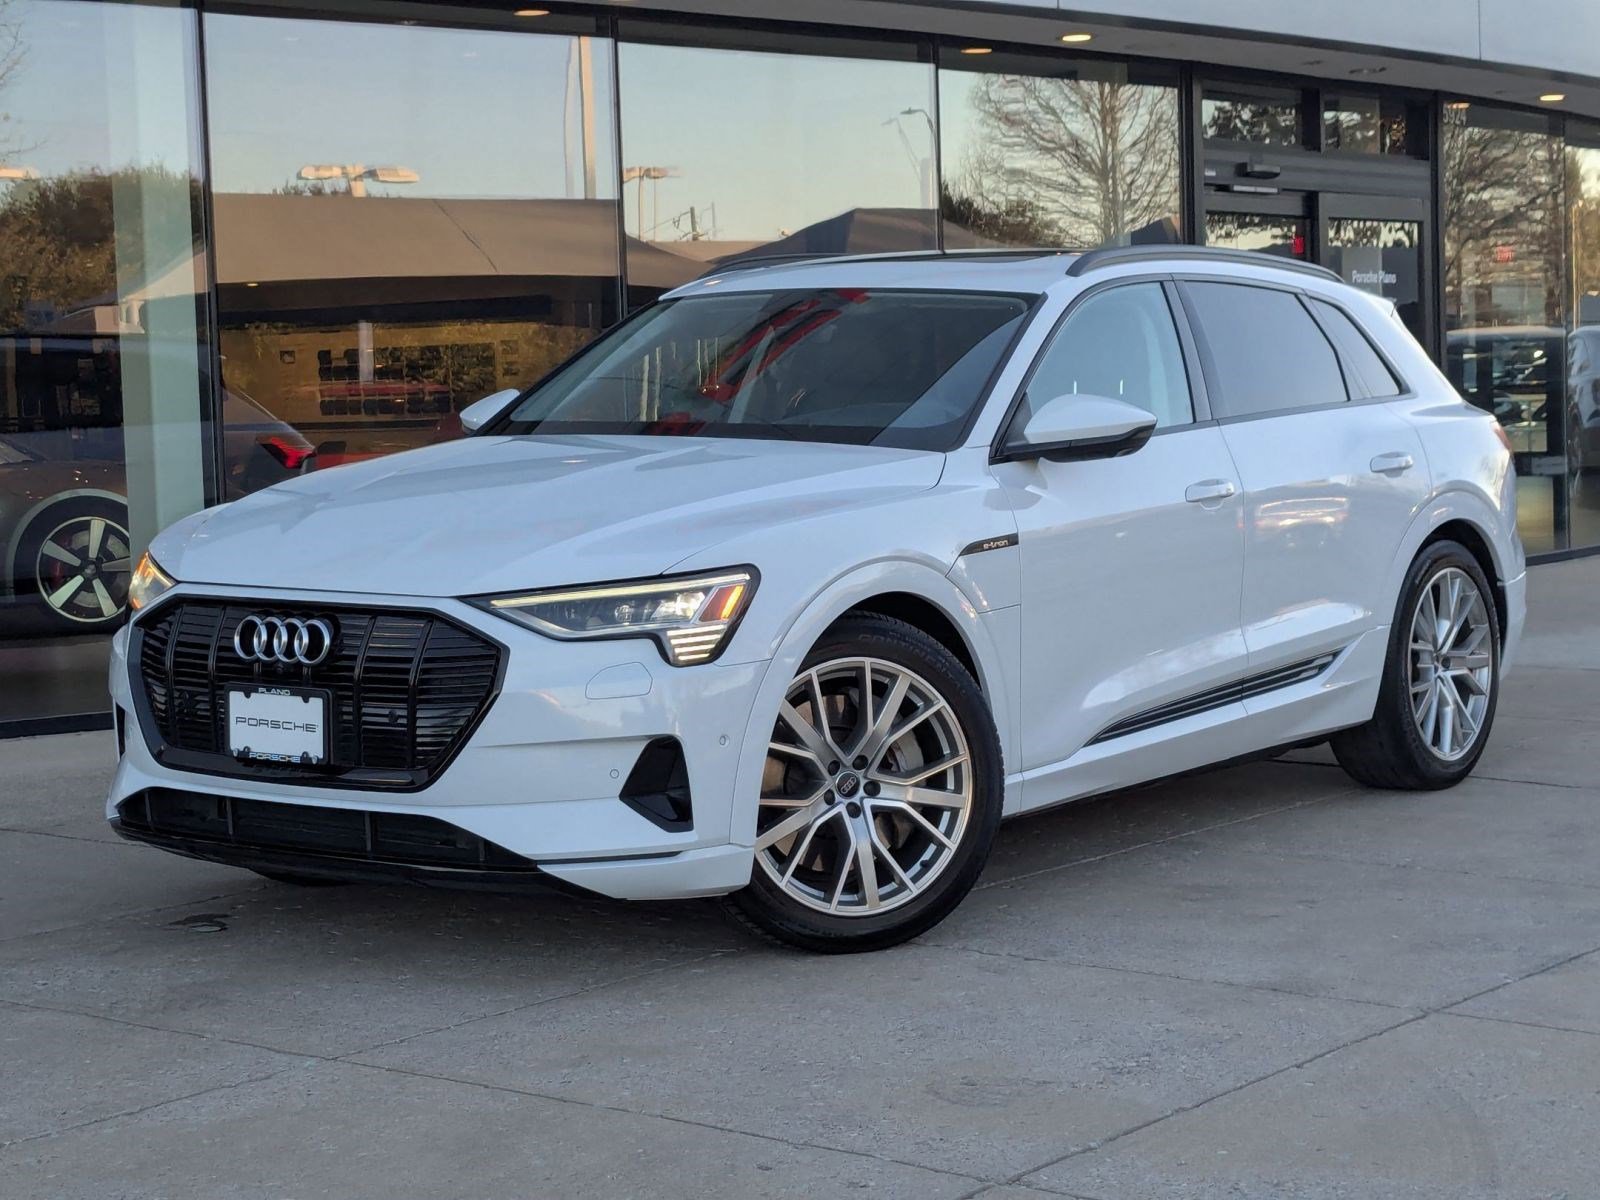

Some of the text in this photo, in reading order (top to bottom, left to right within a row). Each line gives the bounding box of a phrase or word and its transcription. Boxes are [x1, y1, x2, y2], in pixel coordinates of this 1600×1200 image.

[1442, 103, 1467, 126] 5924
[1351, 270, 1397, 284] Porsche Plano
[983, 540, 1009, 549] e-tron
[258, 687, 290, 696] PLANO
[235, 716, 317, 733] PORSCHE
[249, 752, 301, 763] PORSCHE
